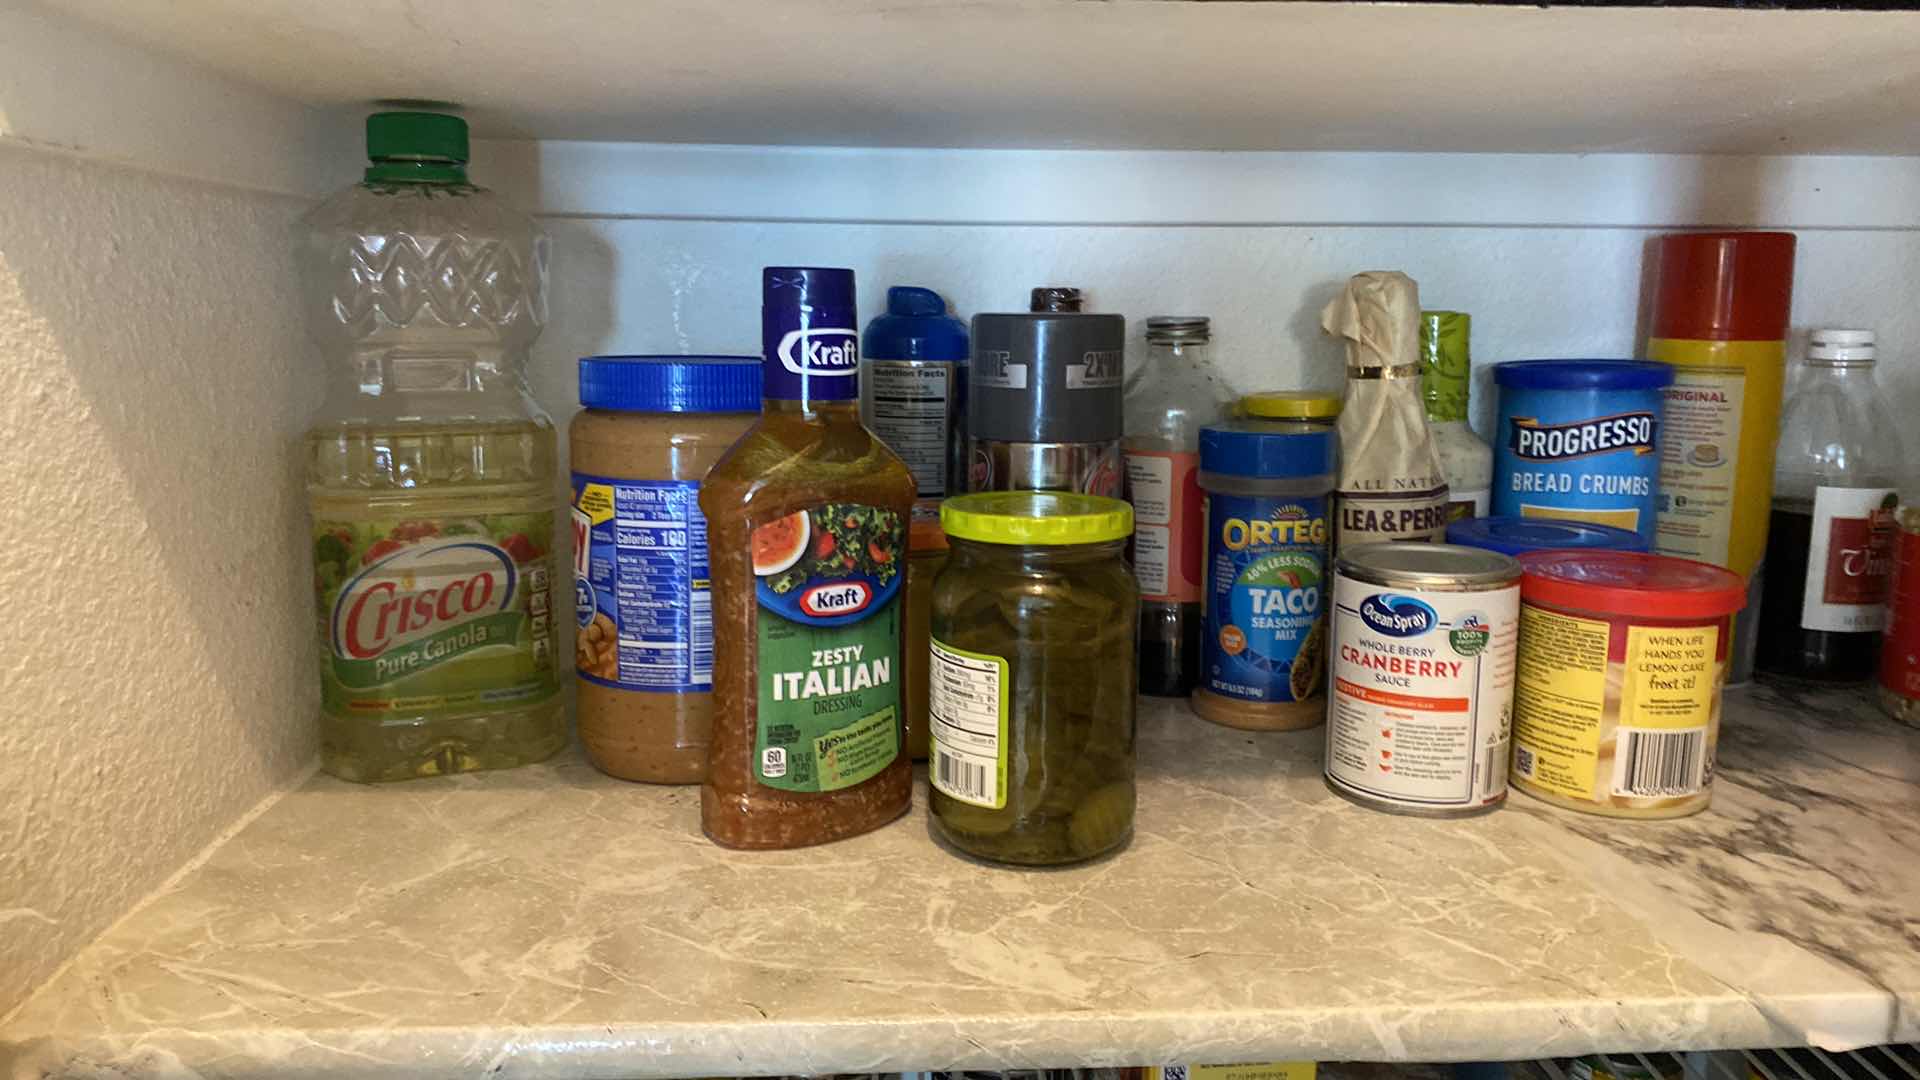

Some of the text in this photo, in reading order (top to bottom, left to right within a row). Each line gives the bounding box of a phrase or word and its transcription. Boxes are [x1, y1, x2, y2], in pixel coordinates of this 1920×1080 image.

[806, 340, 857, 366] Kraft
[873, 368, 945, 379] Nutrition Facts
[1519, 417, 1651, 457] PROGRESSO
[1352, 479, 1385, 490] ALL
[1512, 472, 1650, 496] BREAD CRUMBS
[615, 487, 656, 501] Nutrition
[657, 489, 688, 505] Facts
[617, 531, 656, 546] Calories
[1267, 555, 1293, 569] LESS
[816, 587, 859, 609] Kraft
[1248, 587, 1319, 615] TACO
[345, 571, 495, 659] Crisco
[1363, 602, 1427, 632] Ocean Spray
[1275, 629, 1297, 641] MIX
[1457, 631, 1484, 640] 100%
[1648, 635, 1705, 646] WHEN LIFE
[375, 622, 488, 680] Pure Canola
[811, 644, 864, 668] ZESTY
[1359, 638, 1436, 659] WHOLE BERRY
[1644, 649, 1705, 659] HANDS YOU
[1340, 644, 1463, 679] CRANBERRY
[1639, 663, 1706, 673] LEMON CAKE
[772, 656, 891, 701] ITALIAN
[1375, 672, 1412, 688] SAUCE
[1648, 674, 1697, 690] frost it!
[813, 694, 863, 716] DRESSING
[766, 750, 782, 763] 60
